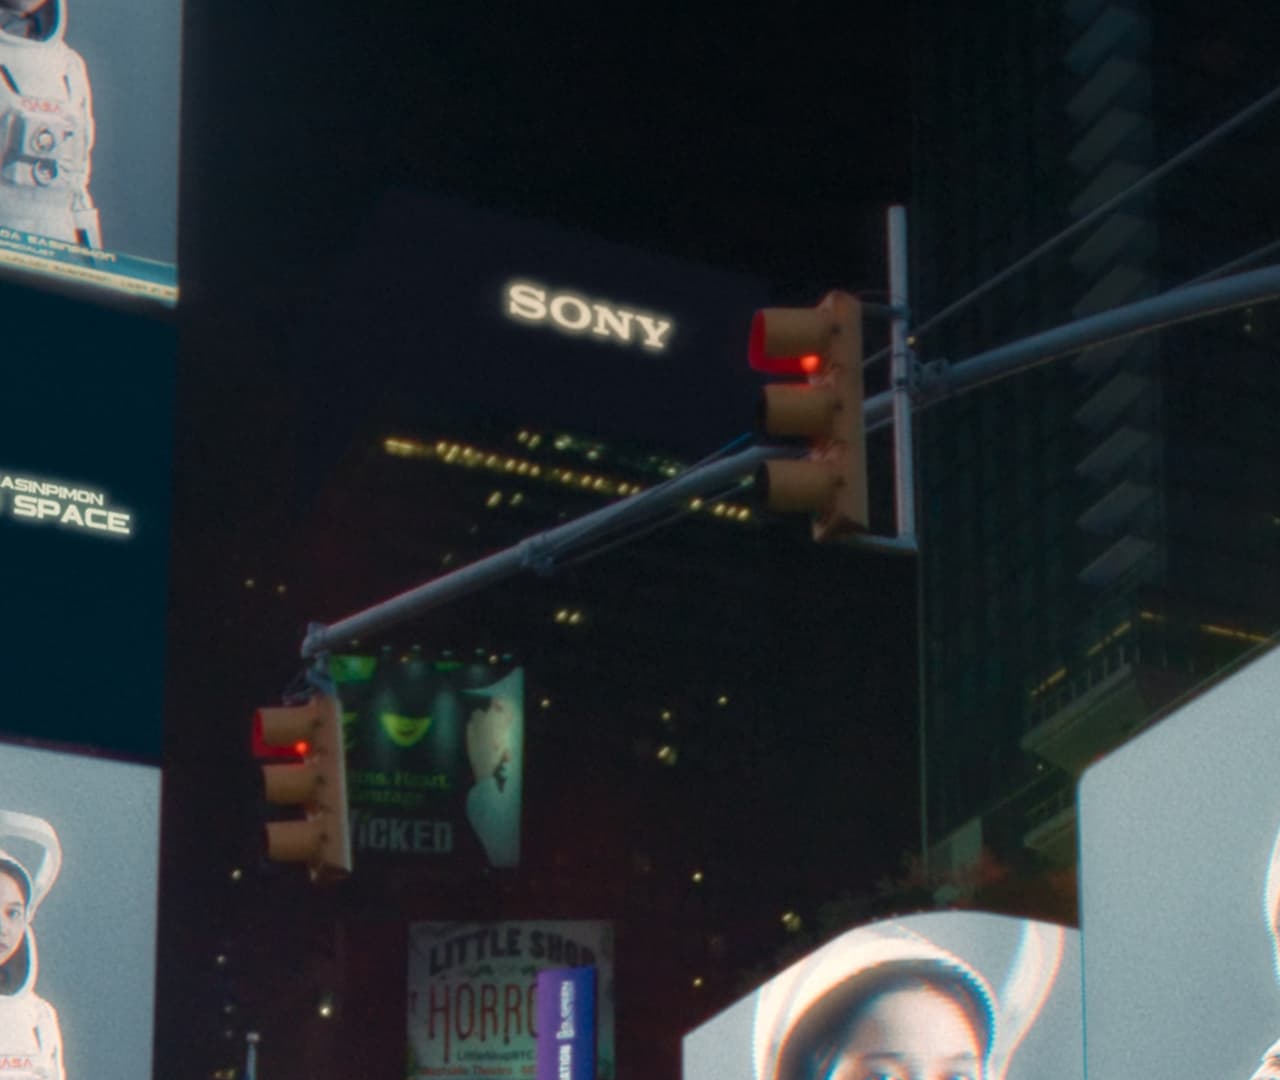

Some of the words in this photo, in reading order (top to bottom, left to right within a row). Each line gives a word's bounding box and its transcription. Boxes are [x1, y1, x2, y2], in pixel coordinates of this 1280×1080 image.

[509, 284, 670, 349] SONY
[13, 494, 131, 535] SPACE
[429, 927, 522, 977] LITTLE
[427, 982, 538, 1065] HORRO
